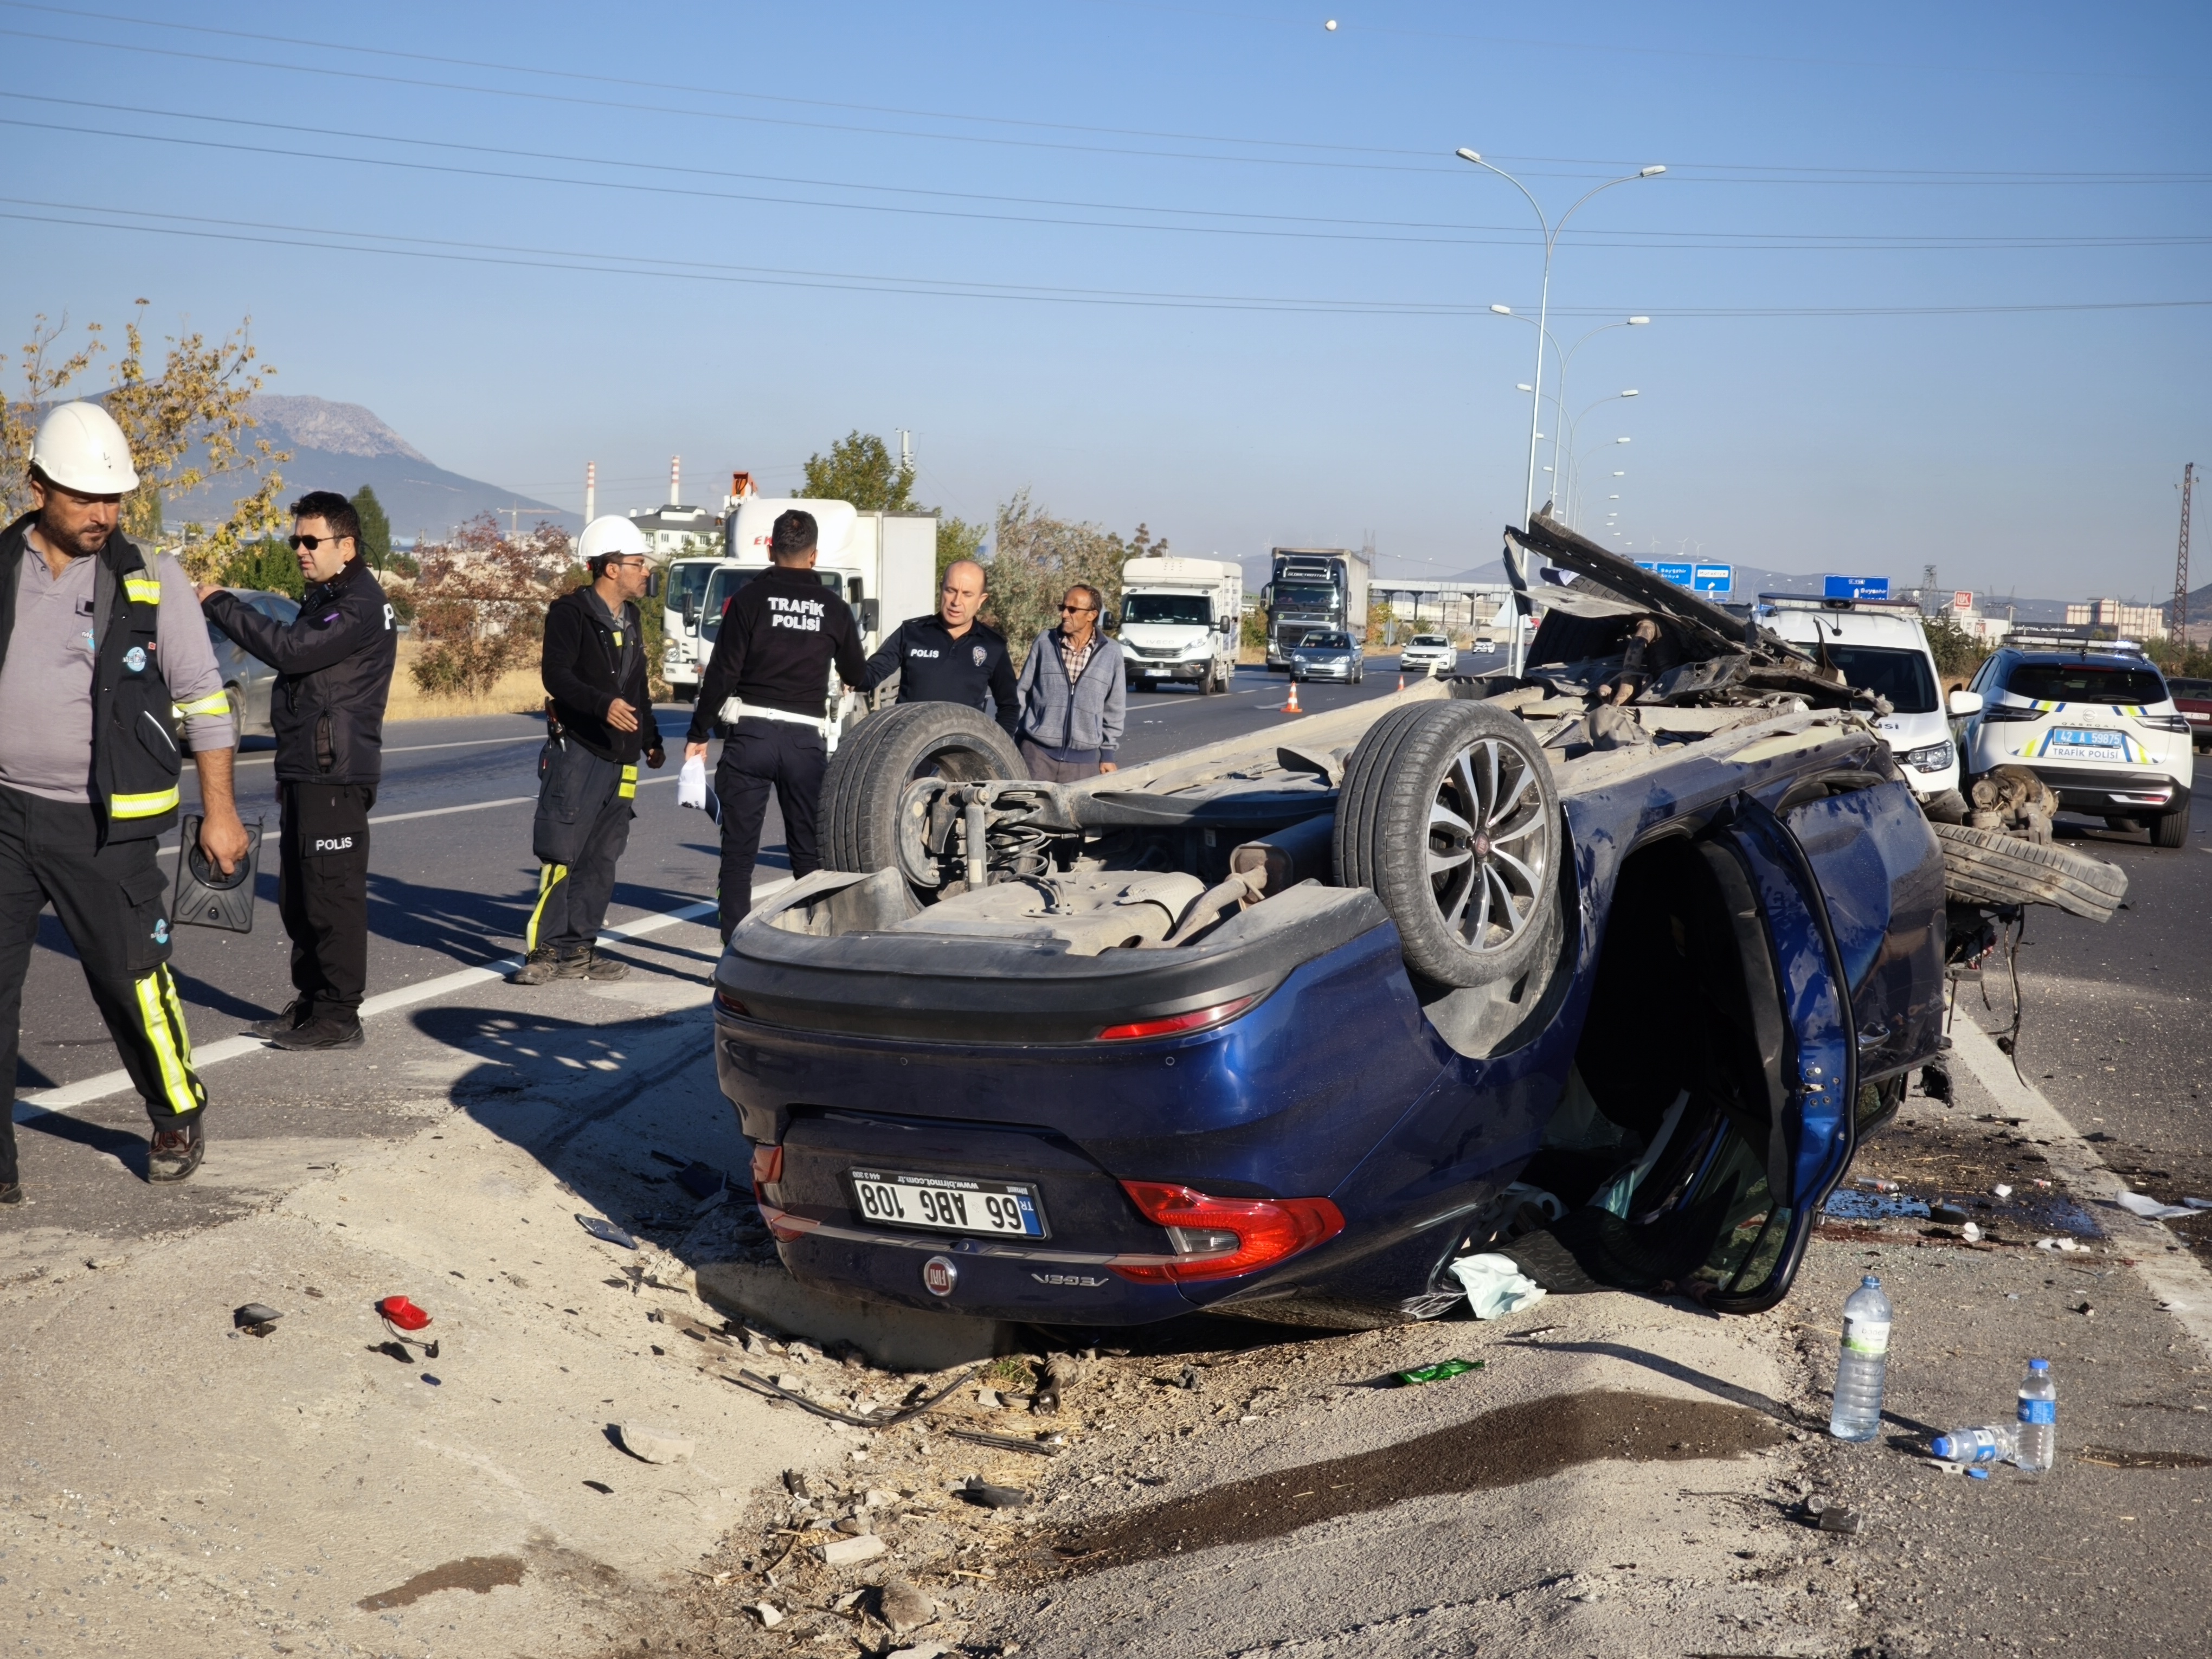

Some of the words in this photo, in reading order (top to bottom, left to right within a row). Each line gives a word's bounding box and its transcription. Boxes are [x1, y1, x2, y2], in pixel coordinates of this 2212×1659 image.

[754, 536, 773, 545] EK
[768, 597, 825, 617] TRAFİK
[772, 614, 820, 632] POLİSİ
[2060, 731, 2073, 742] 42
[2079, 732, 2085, 743] A
[2091, 732, 2120, 744] 59875
[2053, 748, 2085, 757] TRAFİK
[2088, 750, 2118, 759] POLİSİ
[897, 1175, 979, 1189] www.birmot.com.tr
[860, 1183, 905, 1218] 108
[919, 1189, 968, 1226] ABG
[1019, 1200, 1034, 1211] TR
[986, 1195, 1022, 1230] 66
[929, 1269, 947, 1286] FIAT
